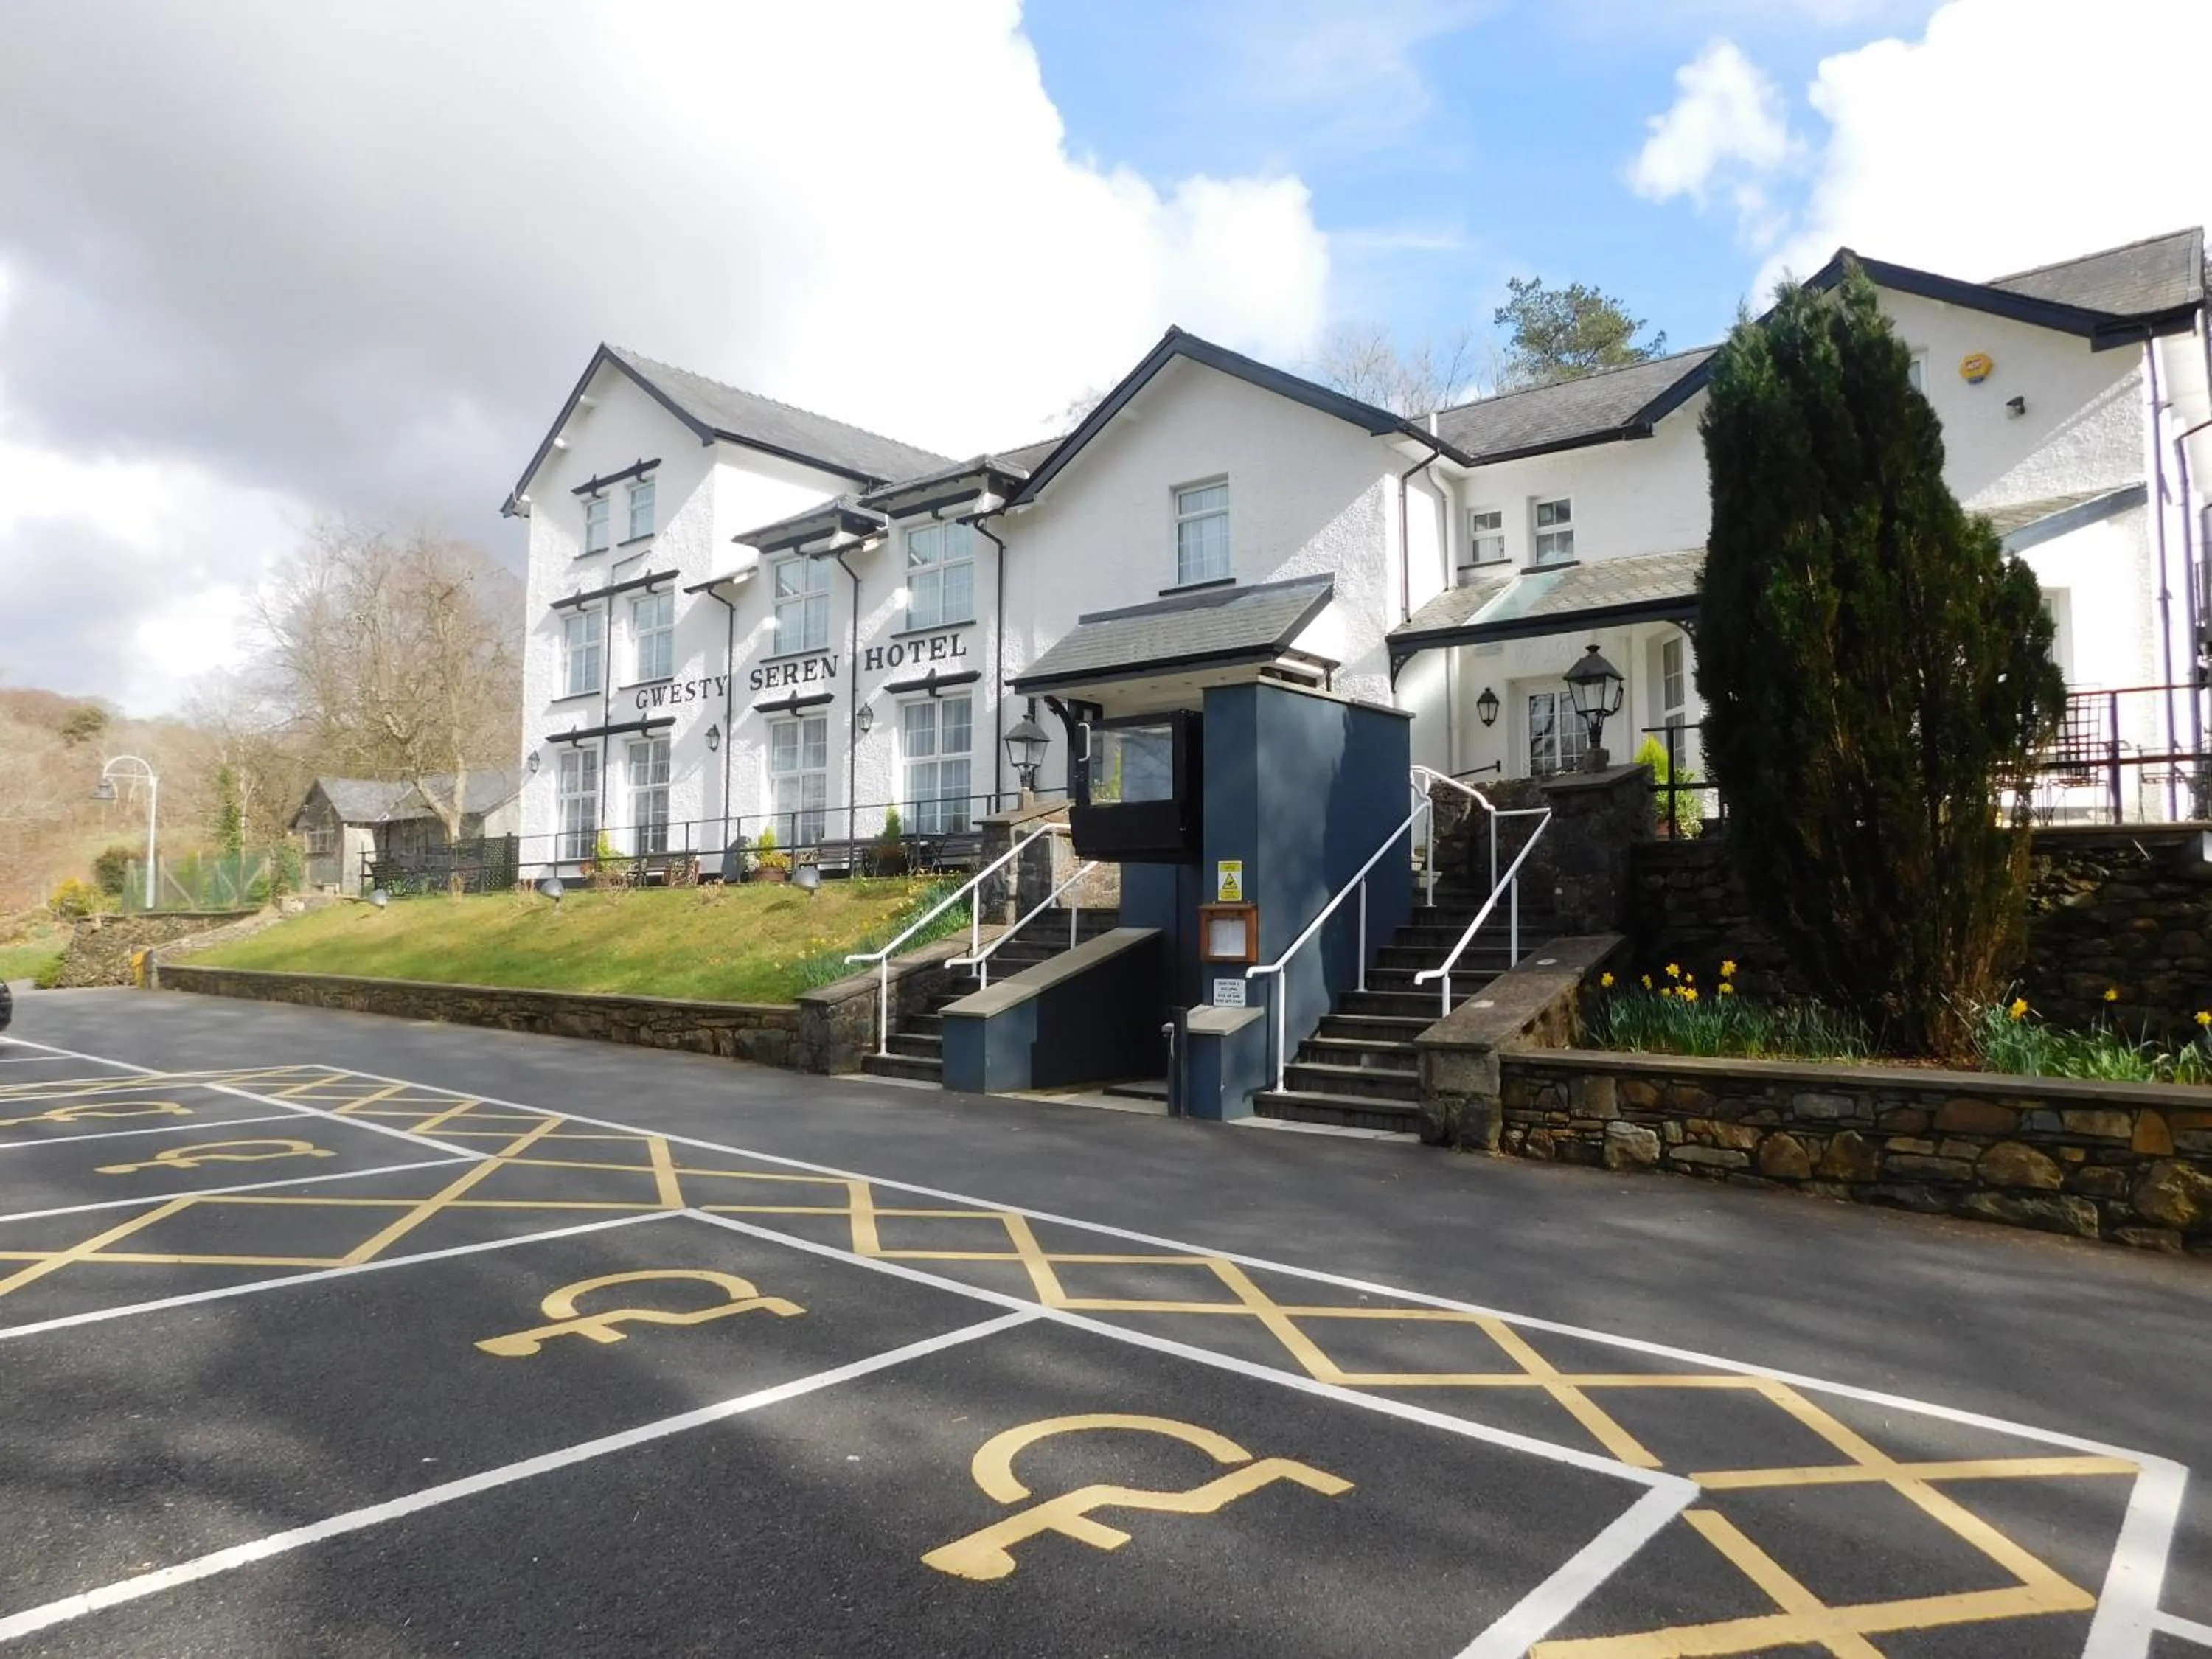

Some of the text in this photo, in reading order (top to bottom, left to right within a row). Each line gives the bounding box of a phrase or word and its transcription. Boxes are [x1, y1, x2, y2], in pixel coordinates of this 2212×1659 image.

[636, 633, 967, 709] GWESTY SEREN HOTEL
